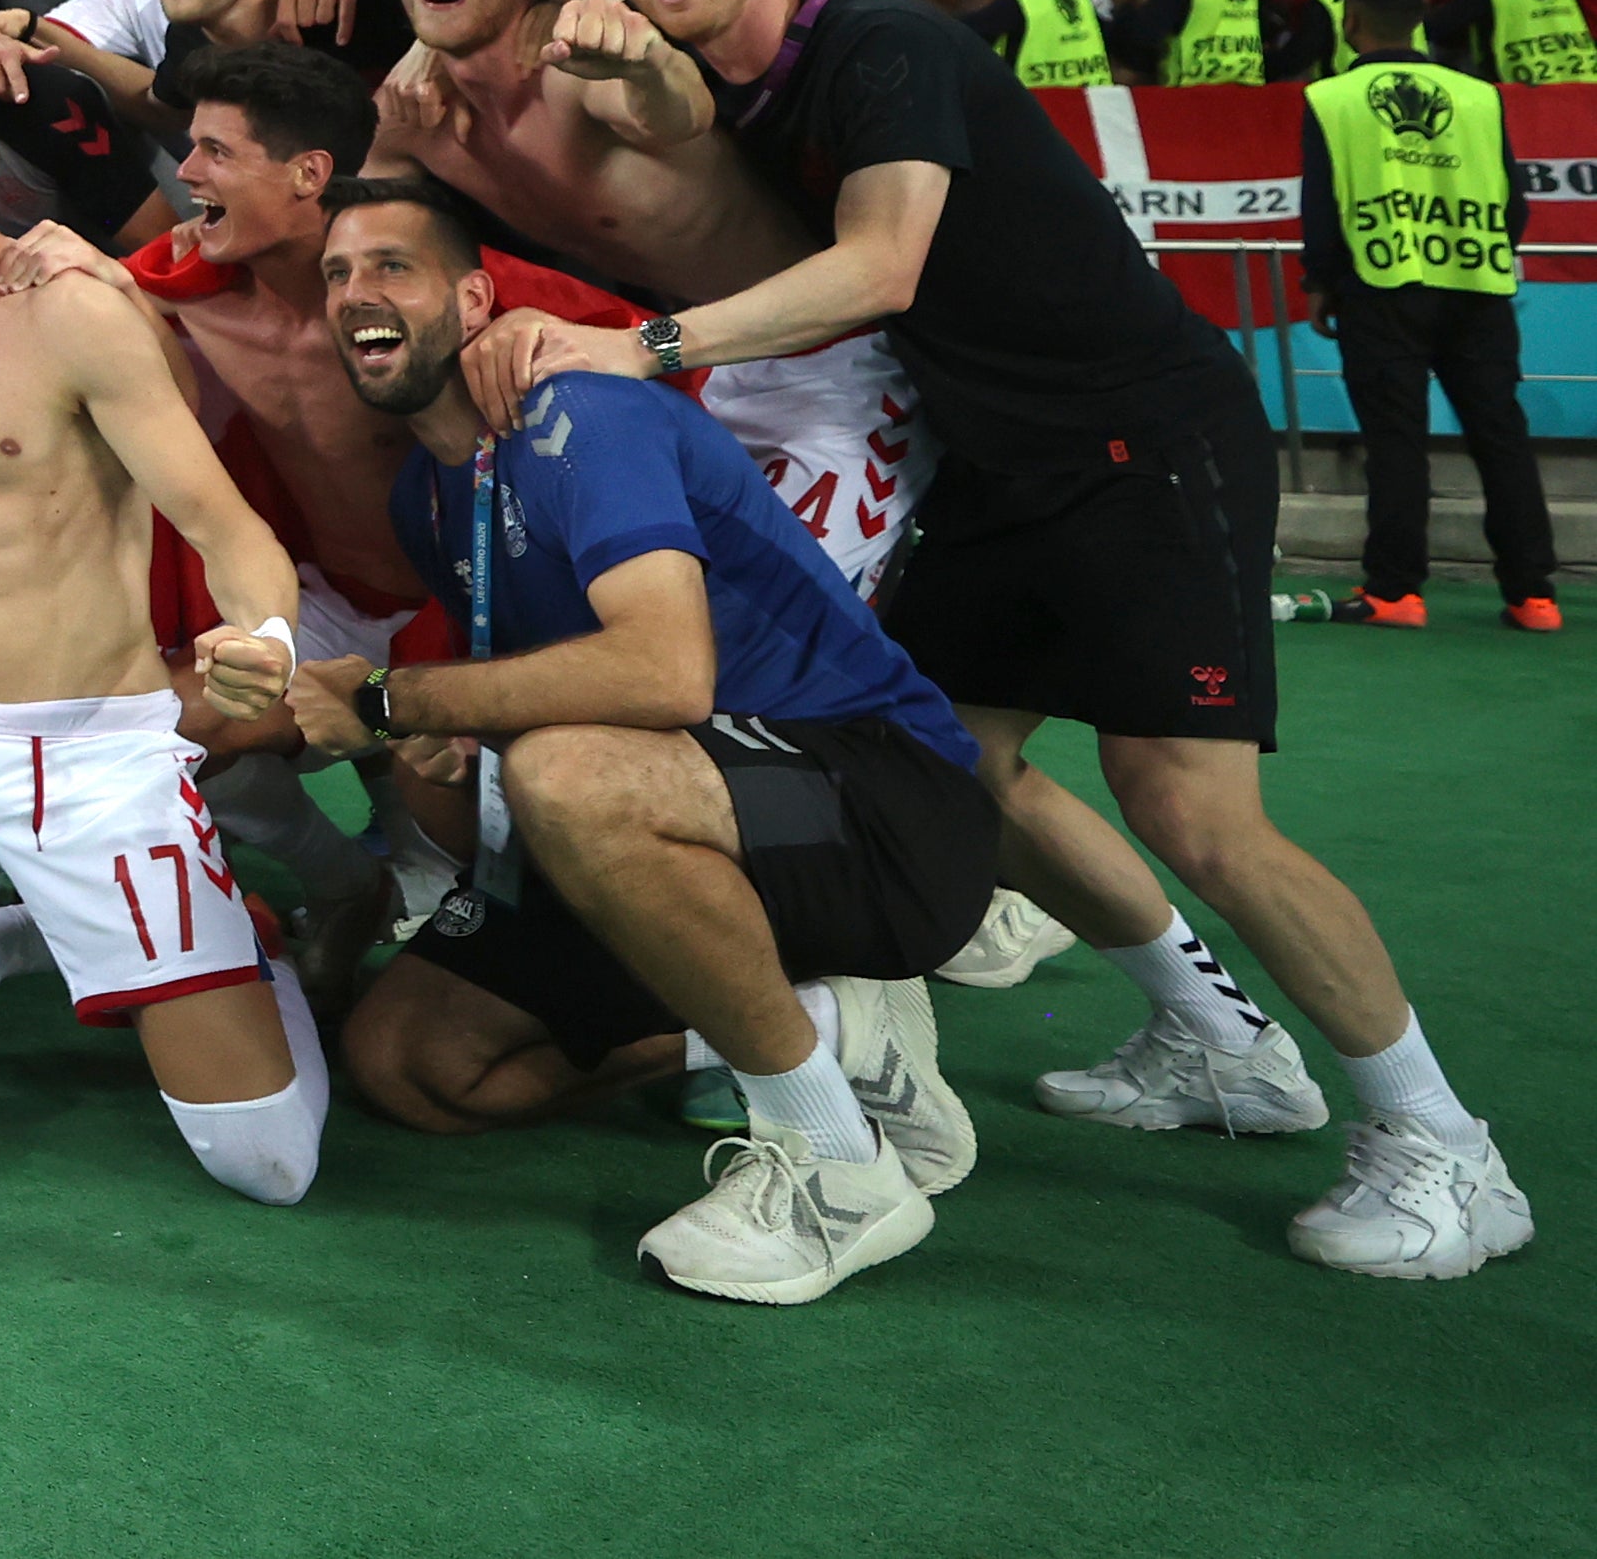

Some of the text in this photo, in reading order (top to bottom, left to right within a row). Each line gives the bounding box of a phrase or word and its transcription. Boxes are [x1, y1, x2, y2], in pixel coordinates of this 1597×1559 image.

[1236, 188, 1290, 215] 22
[476, 522, 487, 604] UEFA EURO 2020
[114, 843, 195, 962] 17
